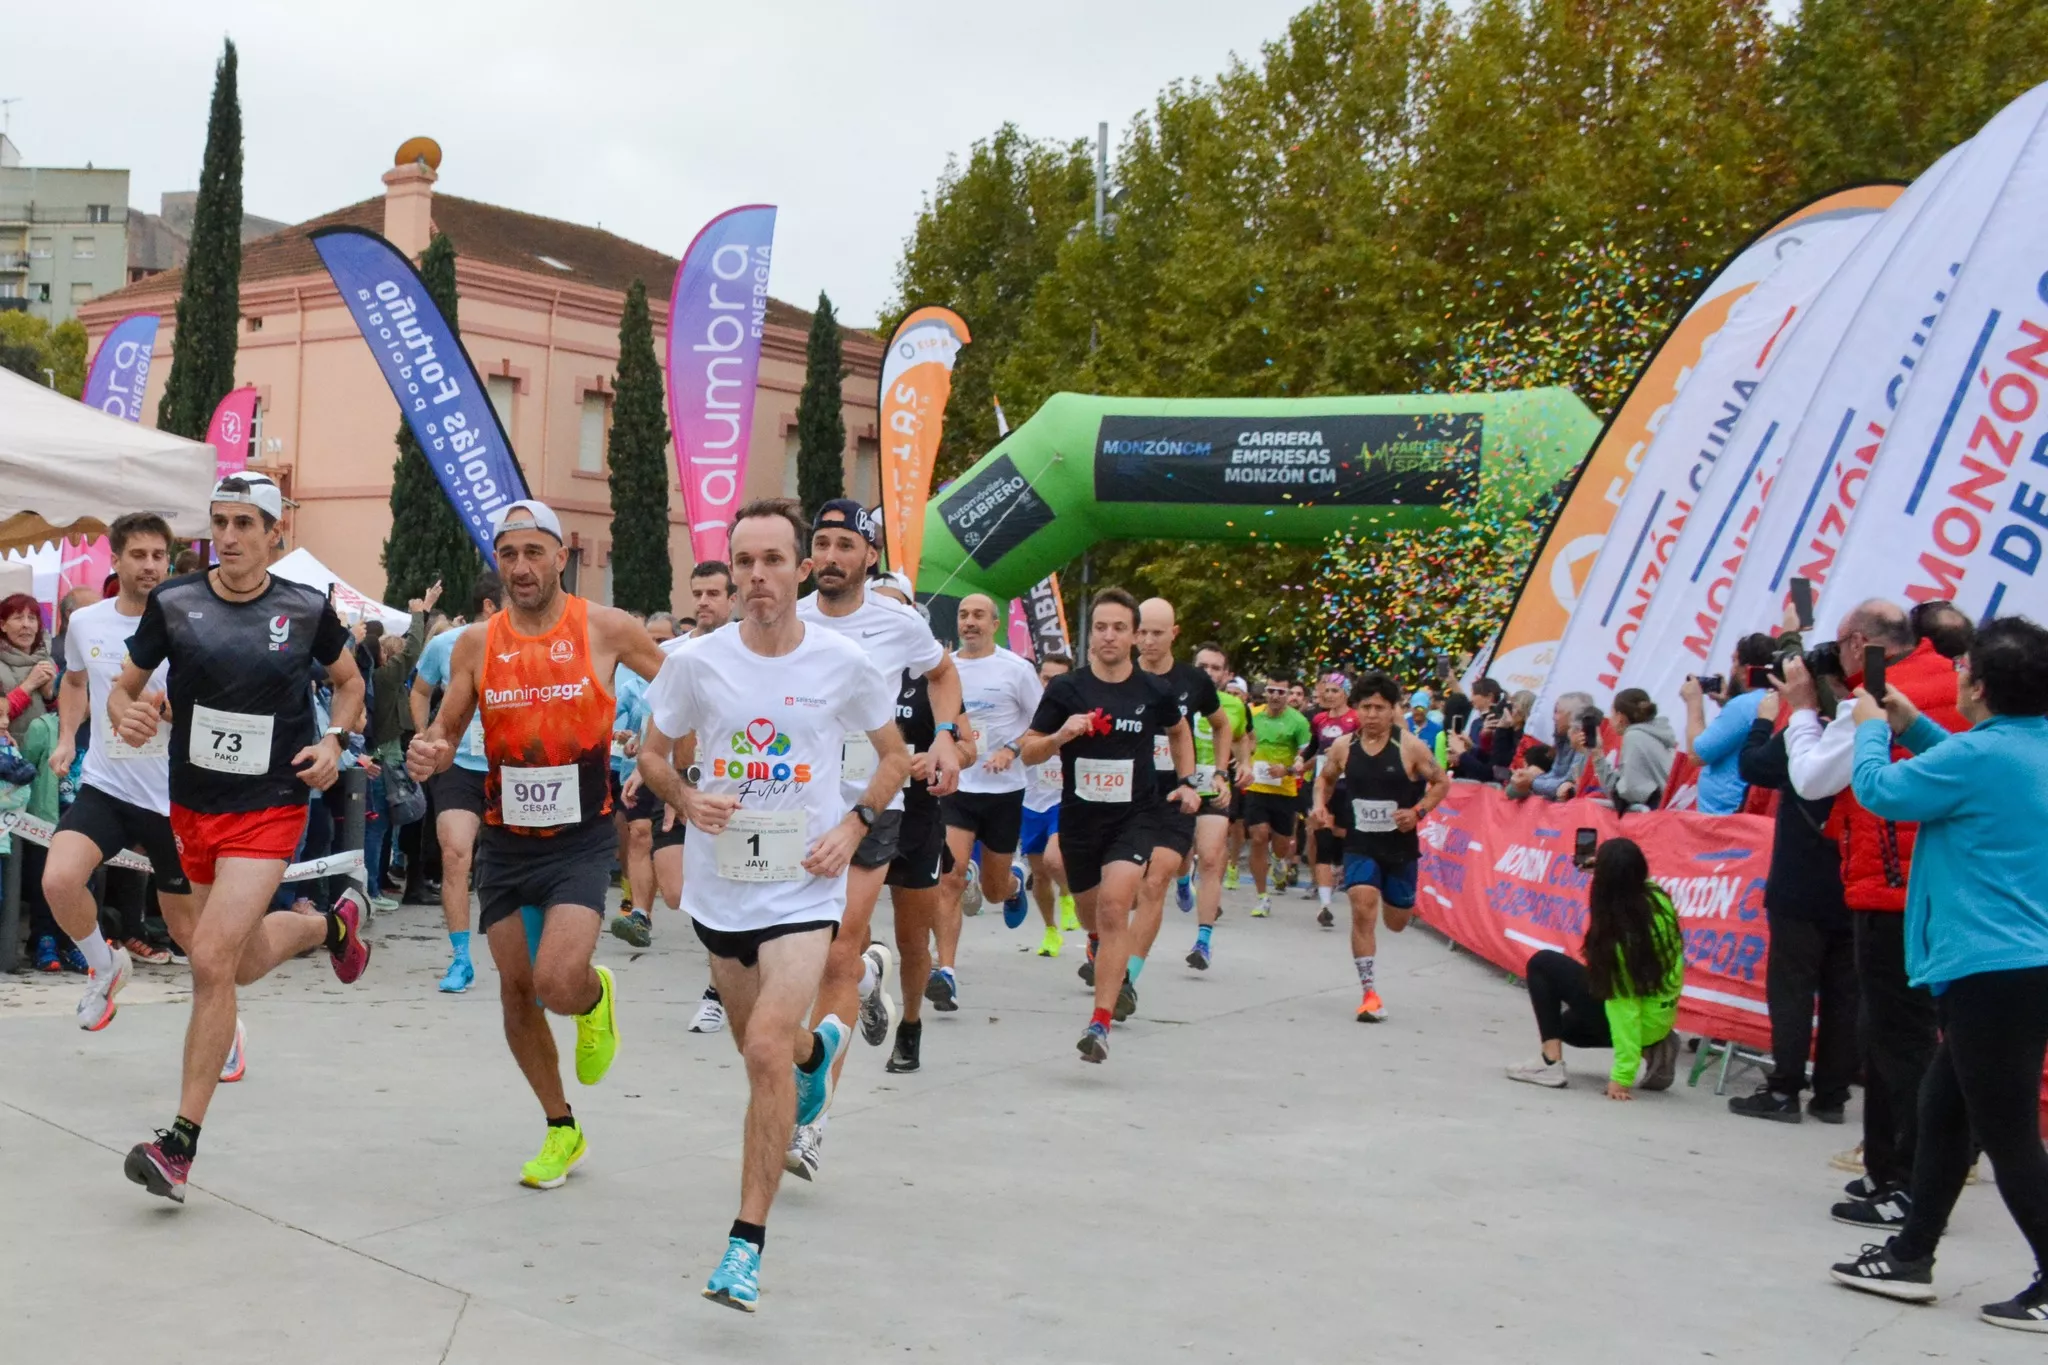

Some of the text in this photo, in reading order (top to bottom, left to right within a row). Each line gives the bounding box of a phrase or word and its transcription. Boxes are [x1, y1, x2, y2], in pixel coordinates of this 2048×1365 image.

[751, 244, 772, 339] ENERGÍA
[130, 344, 152, 418] ENERGÍA
[691, 243, 750, 506] alumbra
[1238, 431, 1323, 446] CARRERA
[1231, 449, 1331, 464] EMPRESAS
[1224, 465, 1337, 483] MONZÓN CM
[946, 477, 1006, 525] Automóviles
[959, 476, 1025, 528] CABRERO
[1115, 719, 1143, 732] MTG
[211, 730, 242, 752] 73
[214, 752, 239, 762] PAKO
[1083, 772, 1125, 787] 1120
[514, 781, 562, 802] 907
[522, 803, 556, 813] CÉSAR
[747, 833, 760, 857] 1
